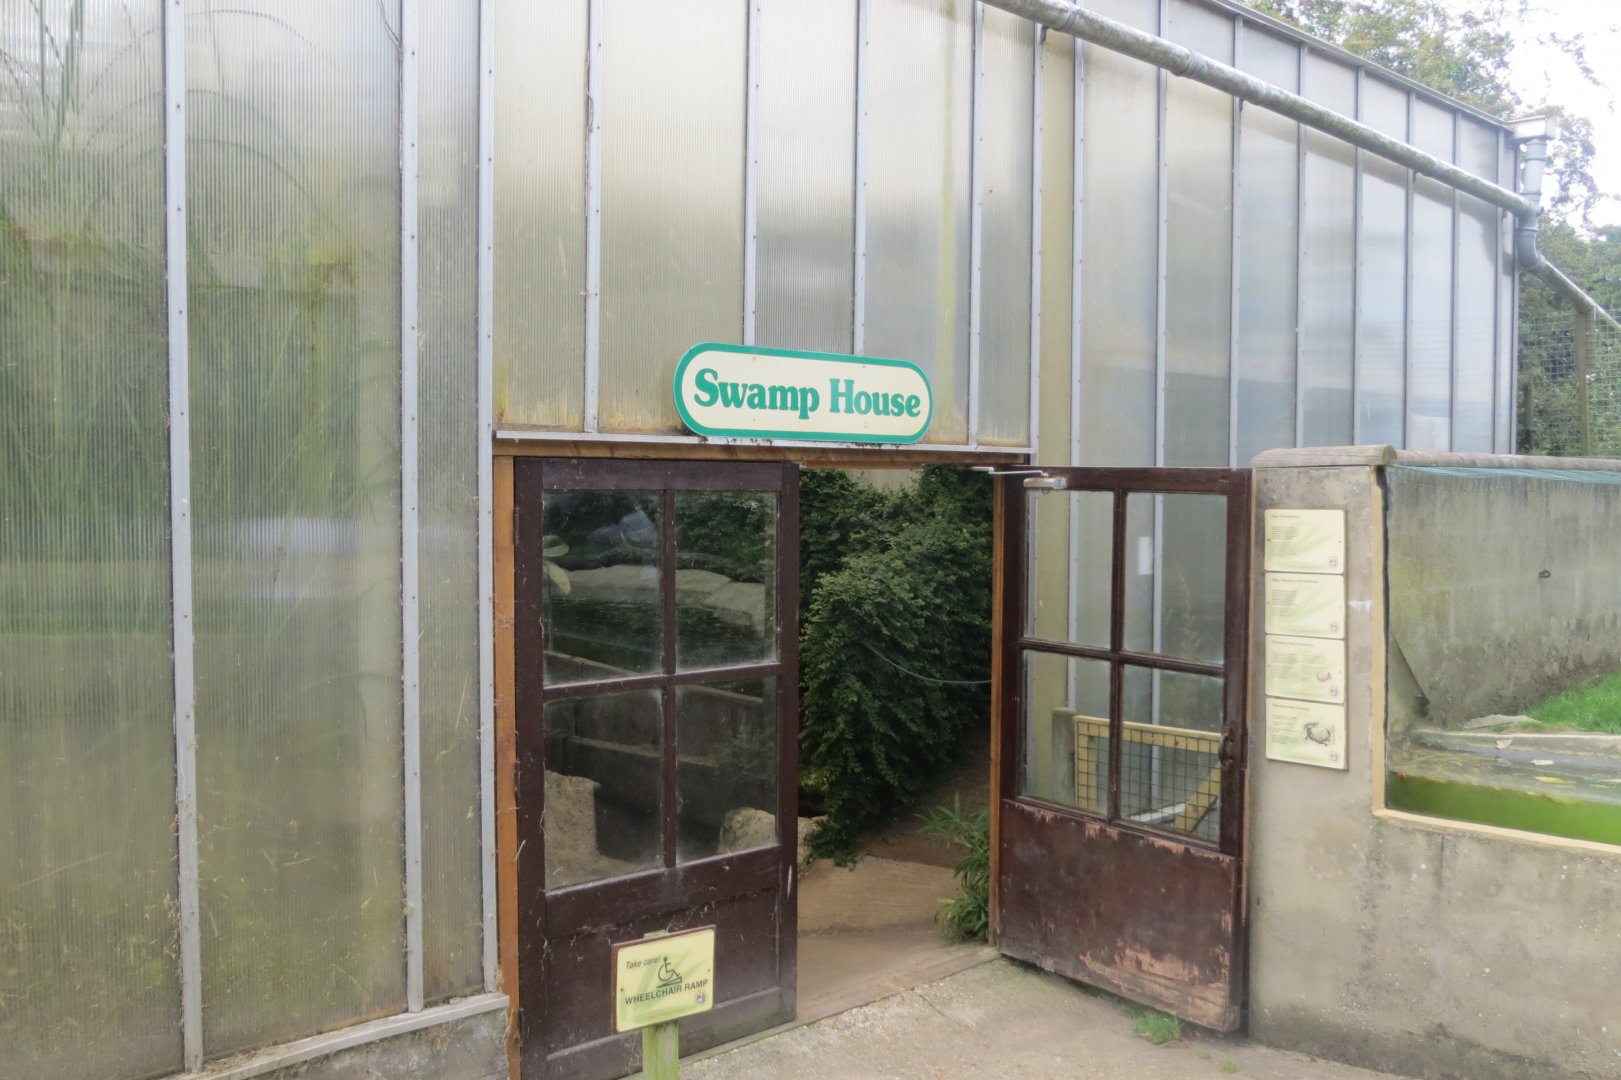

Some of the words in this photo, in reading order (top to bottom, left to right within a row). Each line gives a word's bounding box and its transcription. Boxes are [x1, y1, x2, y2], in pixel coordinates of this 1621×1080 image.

[694, 368, 820, 420] Swamp
[829, 378, 921, 418] House
[626, 960, 642, 969] Take
[643, 955, 661, 966] care!
[625, 985, 682, 1005] WHEELCHAIR
[684, 979, 708, 991] RAMP
